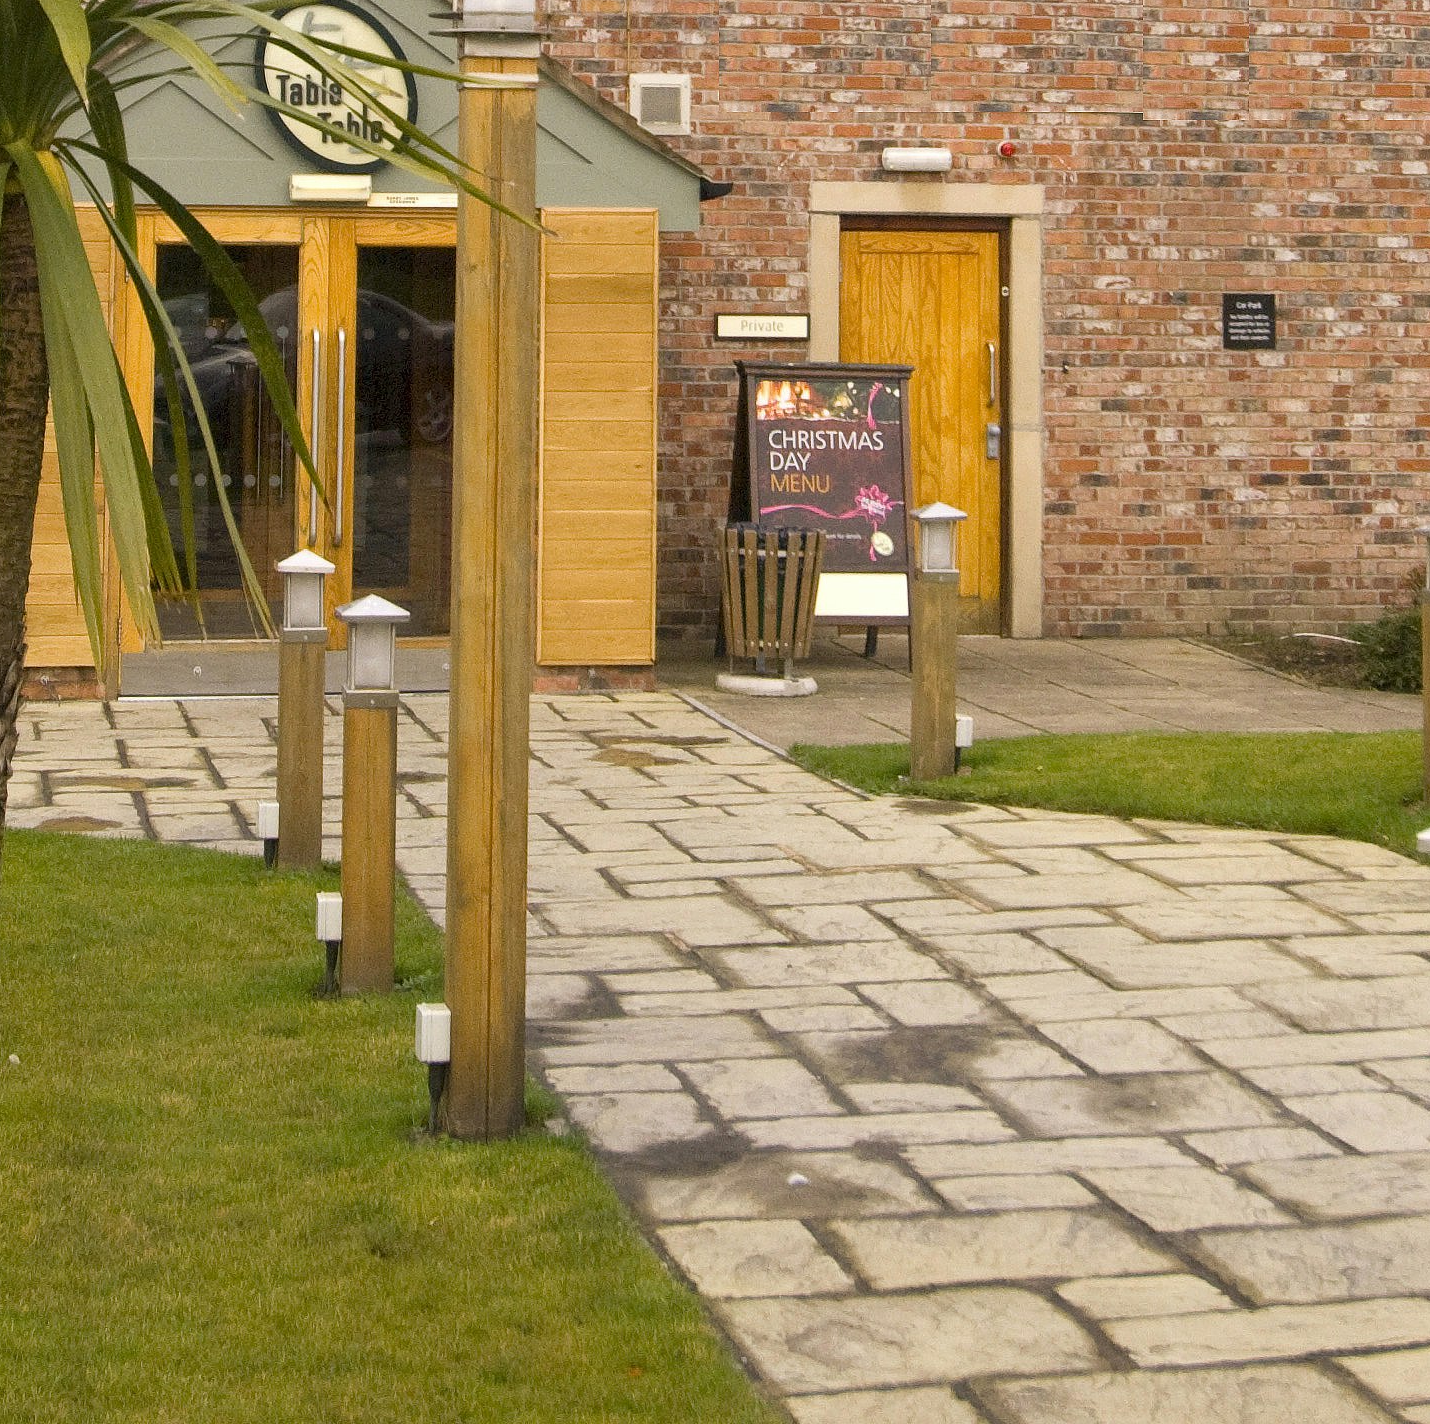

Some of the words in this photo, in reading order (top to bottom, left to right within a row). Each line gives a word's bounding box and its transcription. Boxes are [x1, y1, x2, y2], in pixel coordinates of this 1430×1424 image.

[276, 73, 343, 107] Table
[740, 319, 784, 332] Private
[768, 429, 884, 451] CHRISTMAS
[769, 451, 812, 472] DAY
[770, 473, 830, 494] MENU
